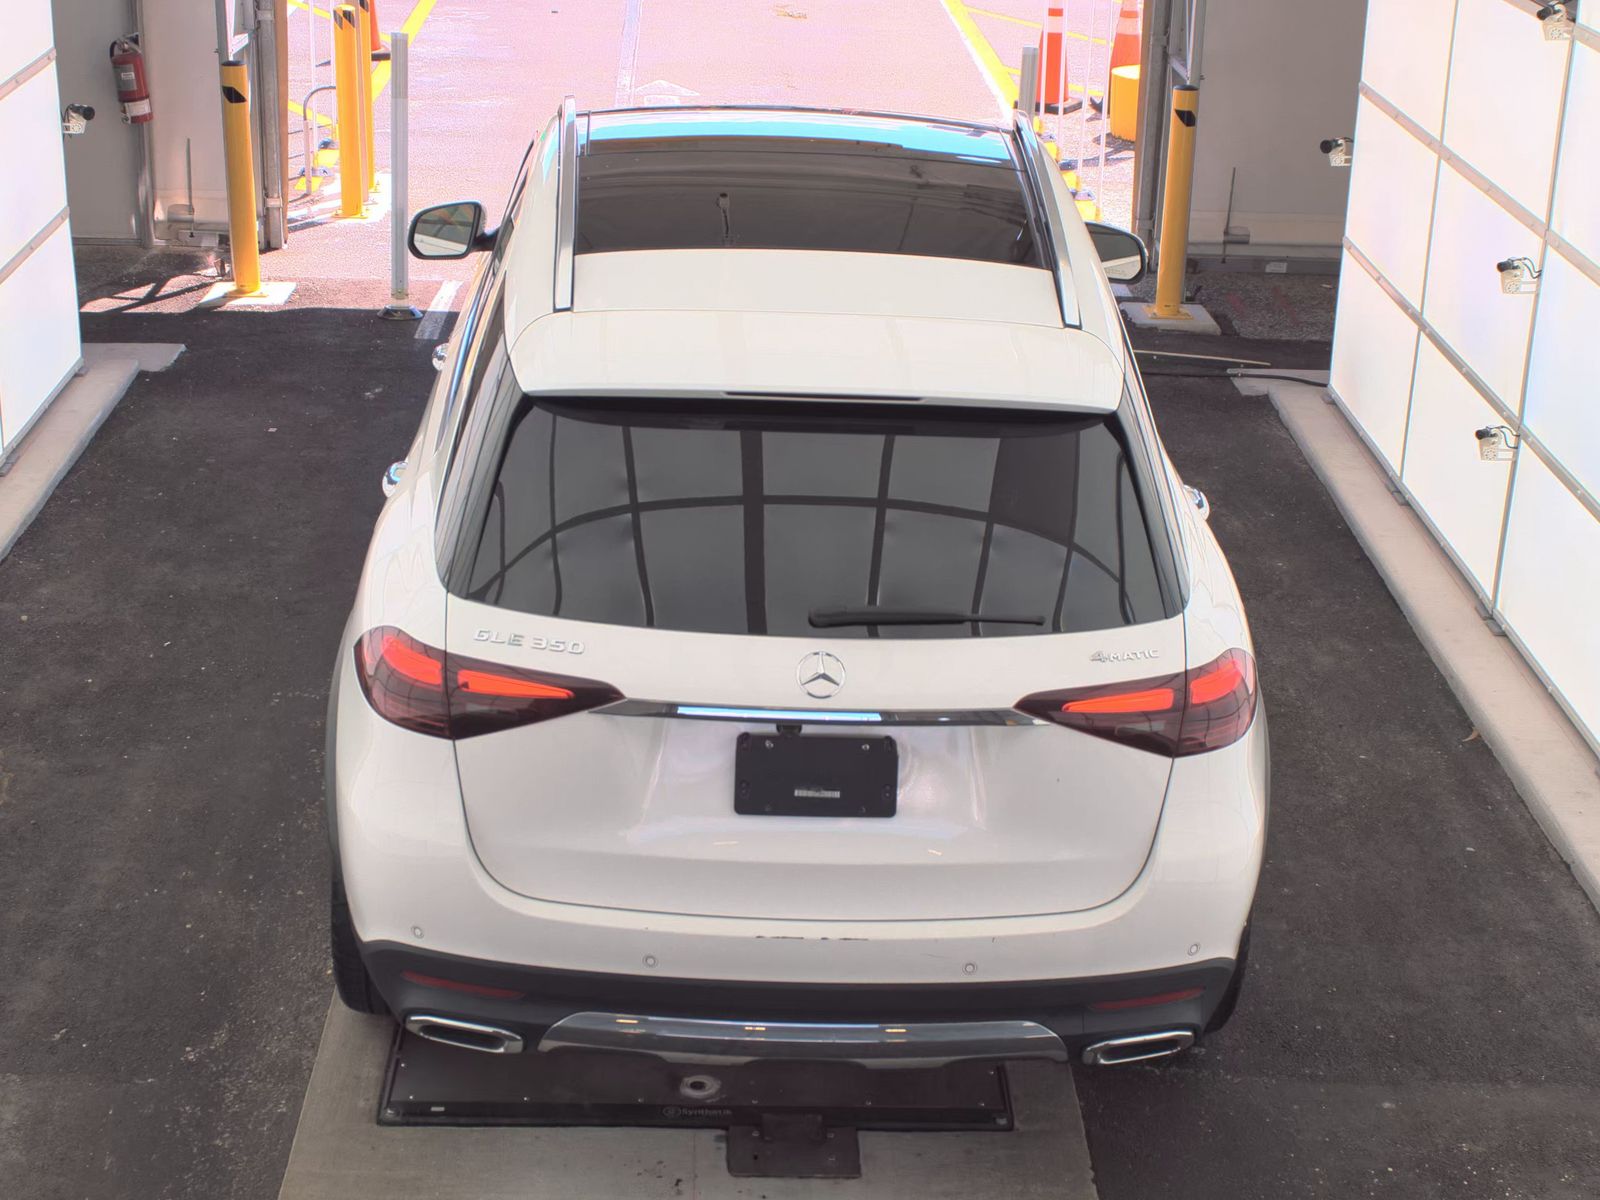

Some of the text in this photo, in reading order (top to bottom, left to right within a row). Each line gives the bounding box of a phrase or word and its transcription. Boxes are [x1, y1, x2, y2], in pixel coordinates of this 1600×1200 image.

[474, 629, 585, 654] GLE 350
[1090, 649, 1159, 662] 4MATIC
